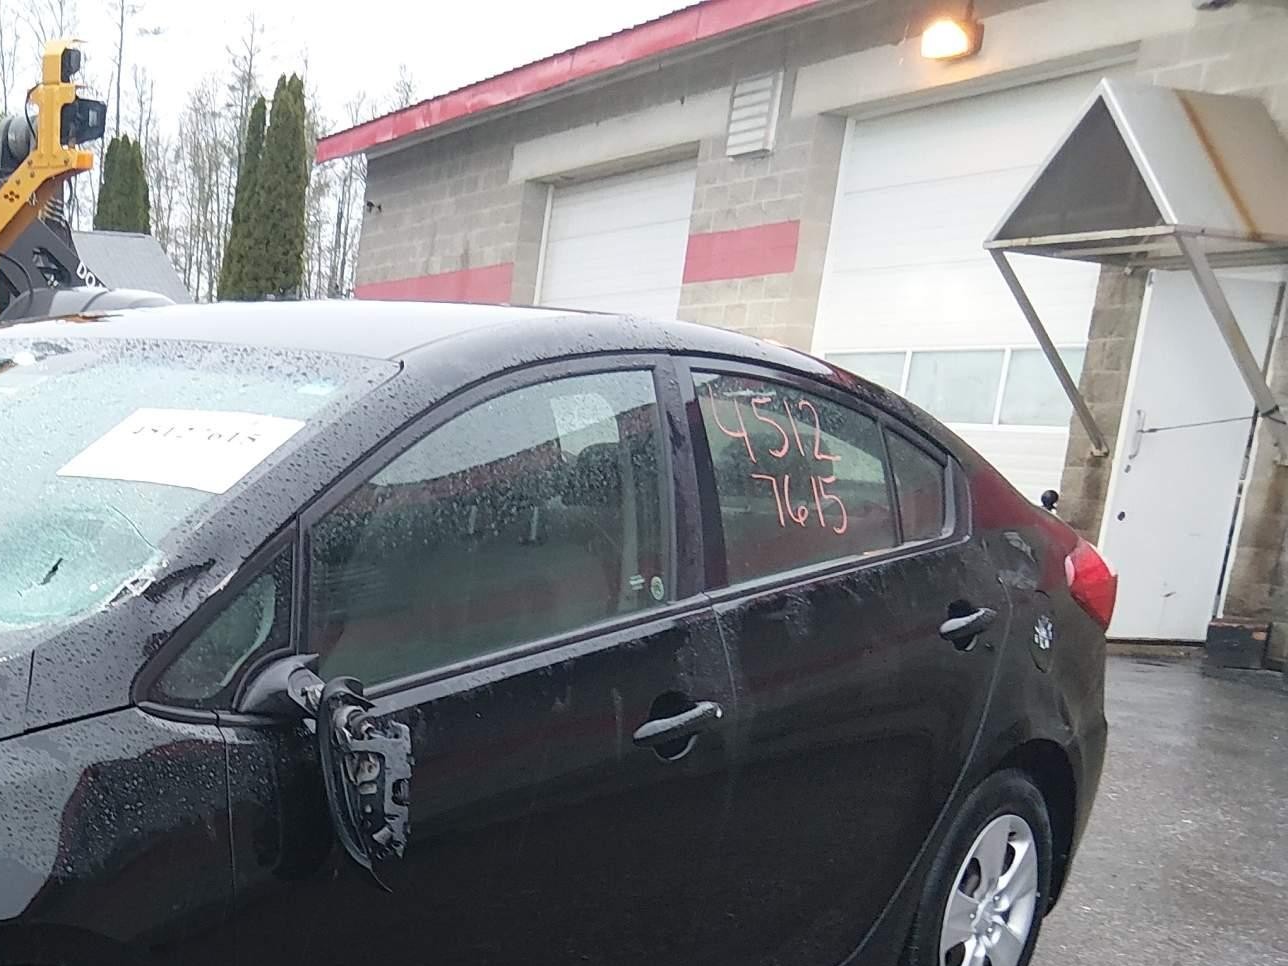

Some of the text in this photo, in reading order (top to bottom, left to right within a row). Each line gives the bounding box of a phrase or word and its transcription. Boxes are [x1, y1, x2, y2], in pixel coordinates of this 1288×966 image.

[76, 260, 105, 289] DO
[708, 384, 841, 464] 4512
[750, 473, 848, 535] 7615
